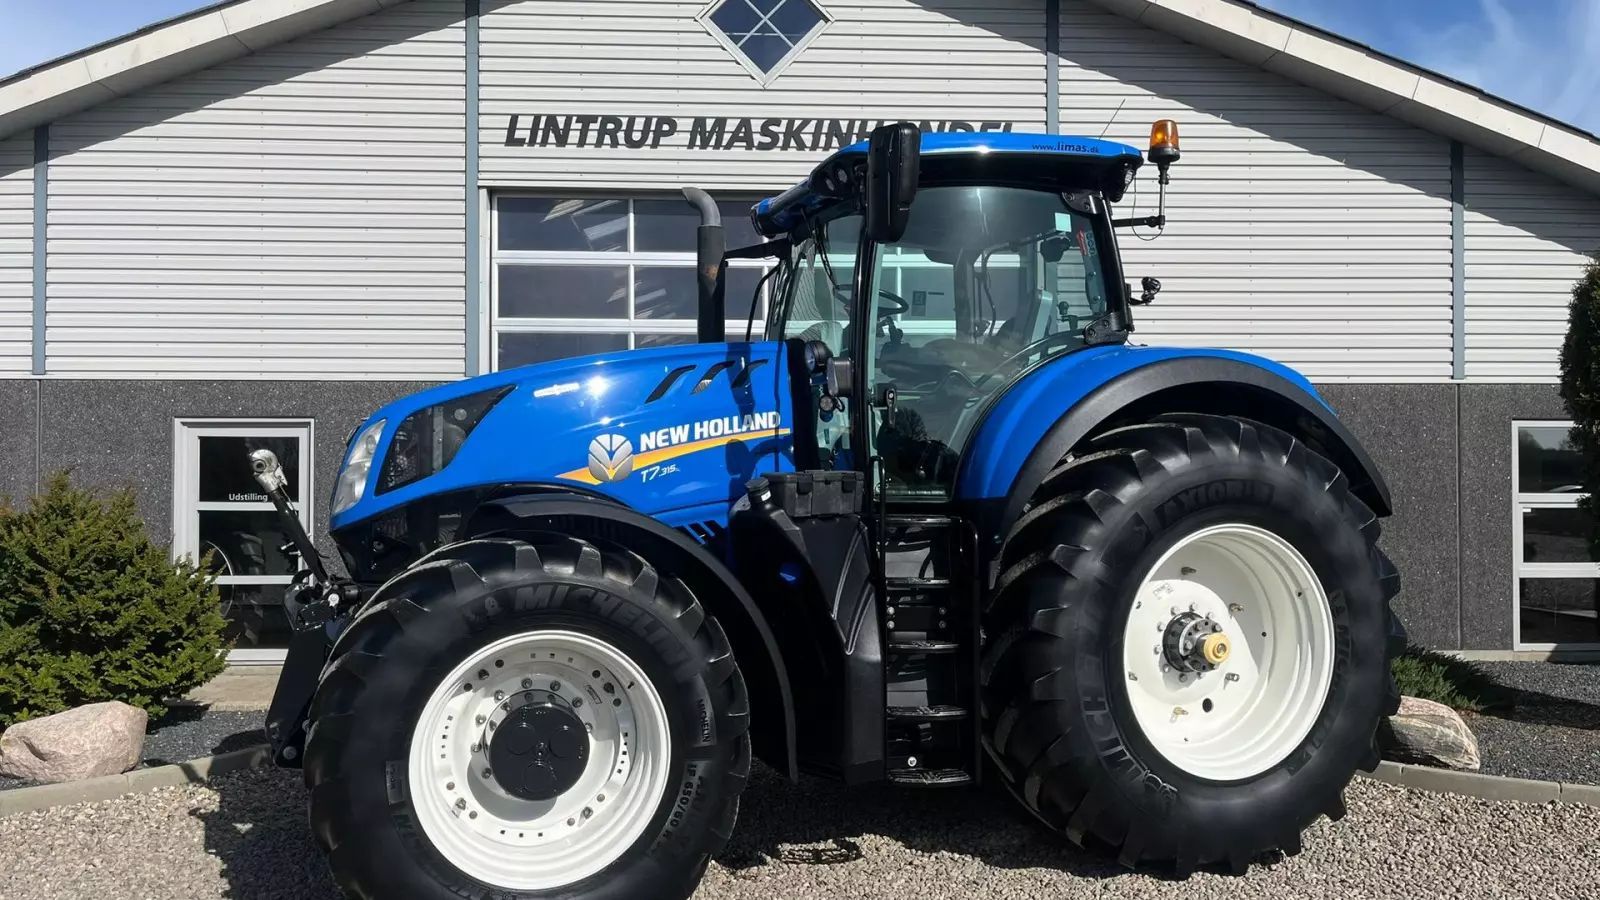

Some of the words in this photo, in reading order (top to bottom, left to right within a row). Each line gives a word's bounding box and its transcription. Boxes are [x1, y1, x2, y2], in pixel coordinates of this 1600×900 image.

[505, 115, 678, 149] LINTRUP
[640, 424, 690, 452] NEW
[694, 411, 781, 440] HOLLAND
[228, 492, 269, 503] Udstilling
